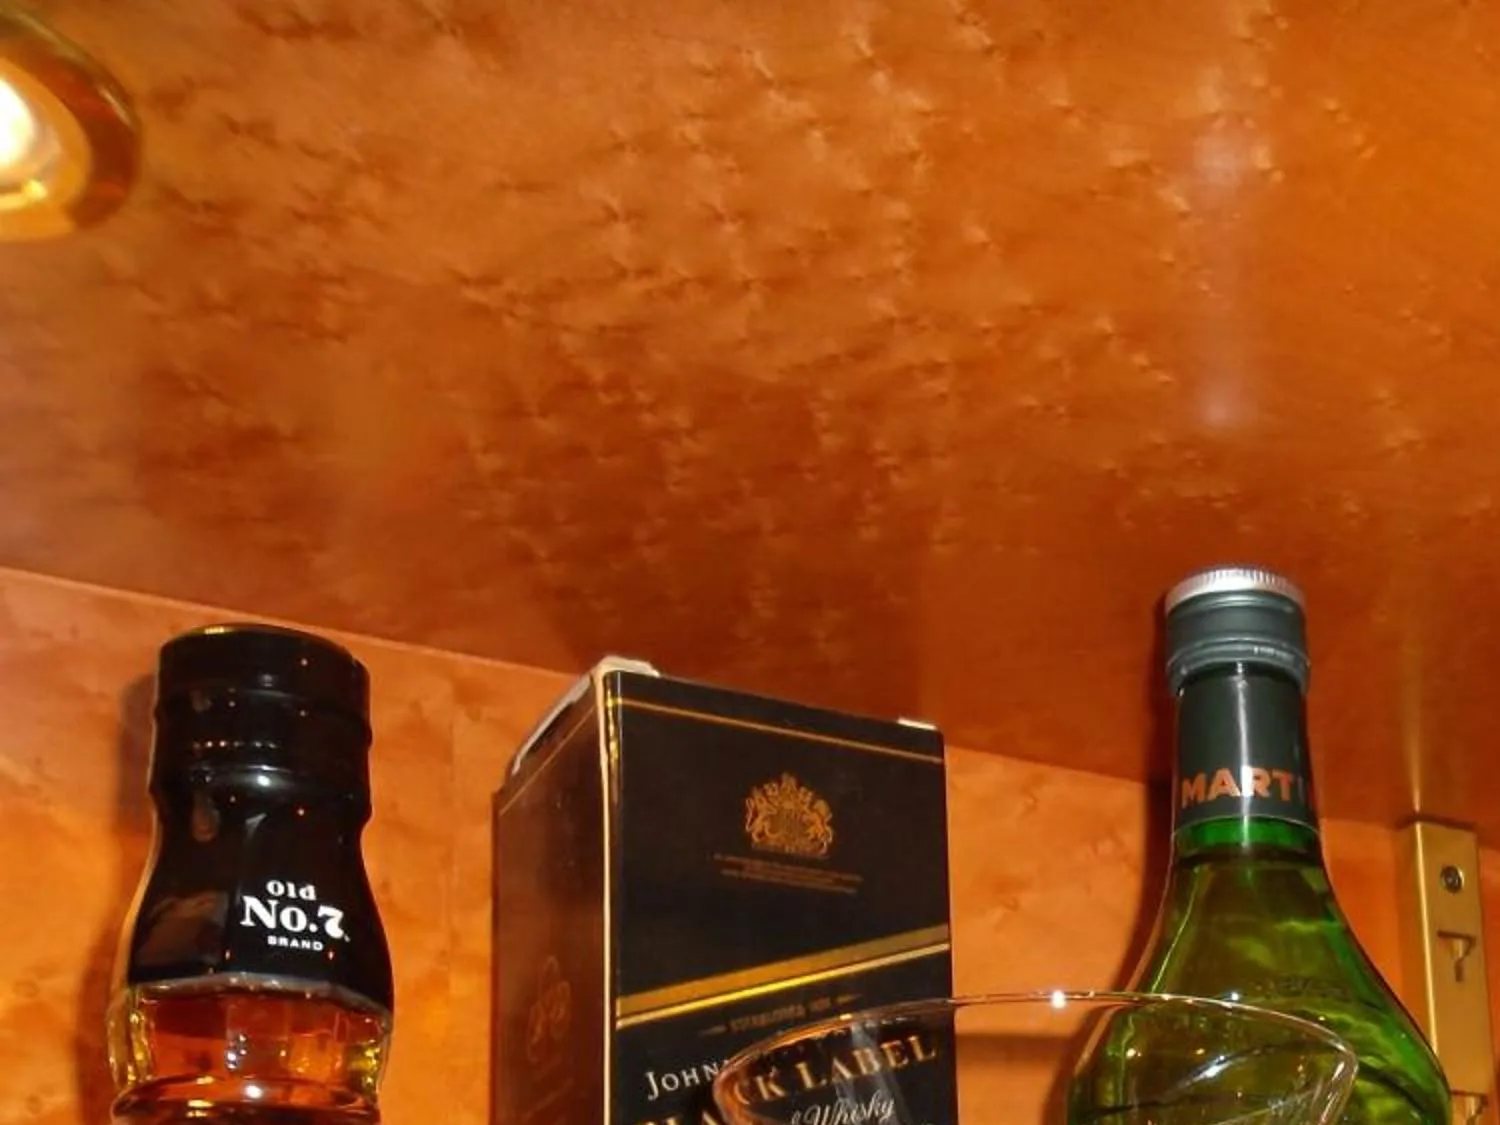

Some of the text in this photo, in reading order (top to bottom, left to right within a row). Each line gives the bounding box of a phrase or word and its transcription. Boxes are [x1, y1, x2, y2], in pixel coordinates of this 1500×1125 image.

[266, 880, 316, 900] Old
[240, 895, 344, 939] No.7
[267, 935, 323, 951] BRAND
